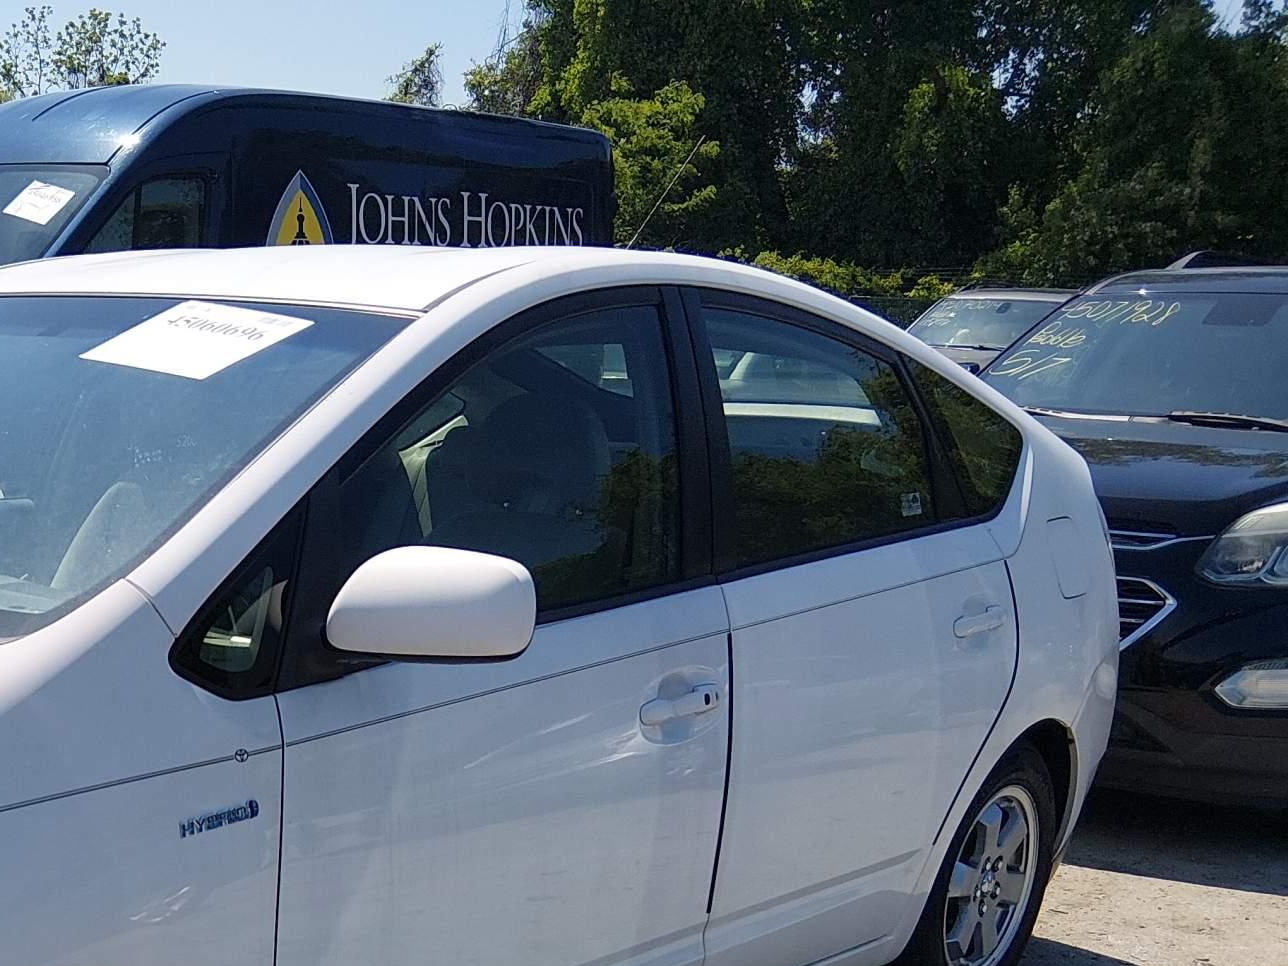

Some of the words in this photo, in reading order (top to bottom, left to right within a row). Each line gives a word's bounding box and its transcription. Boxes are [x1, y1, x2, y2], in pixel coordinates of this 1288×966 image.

[347, 183, 450, 246] JOHNS
[461, 191, 583, 247] HOPKINS
[167, 315, 264, 341] 45060696
[988, 349, 1073, 380] 5/7
[178, 799, 259, 838] HYBRID
